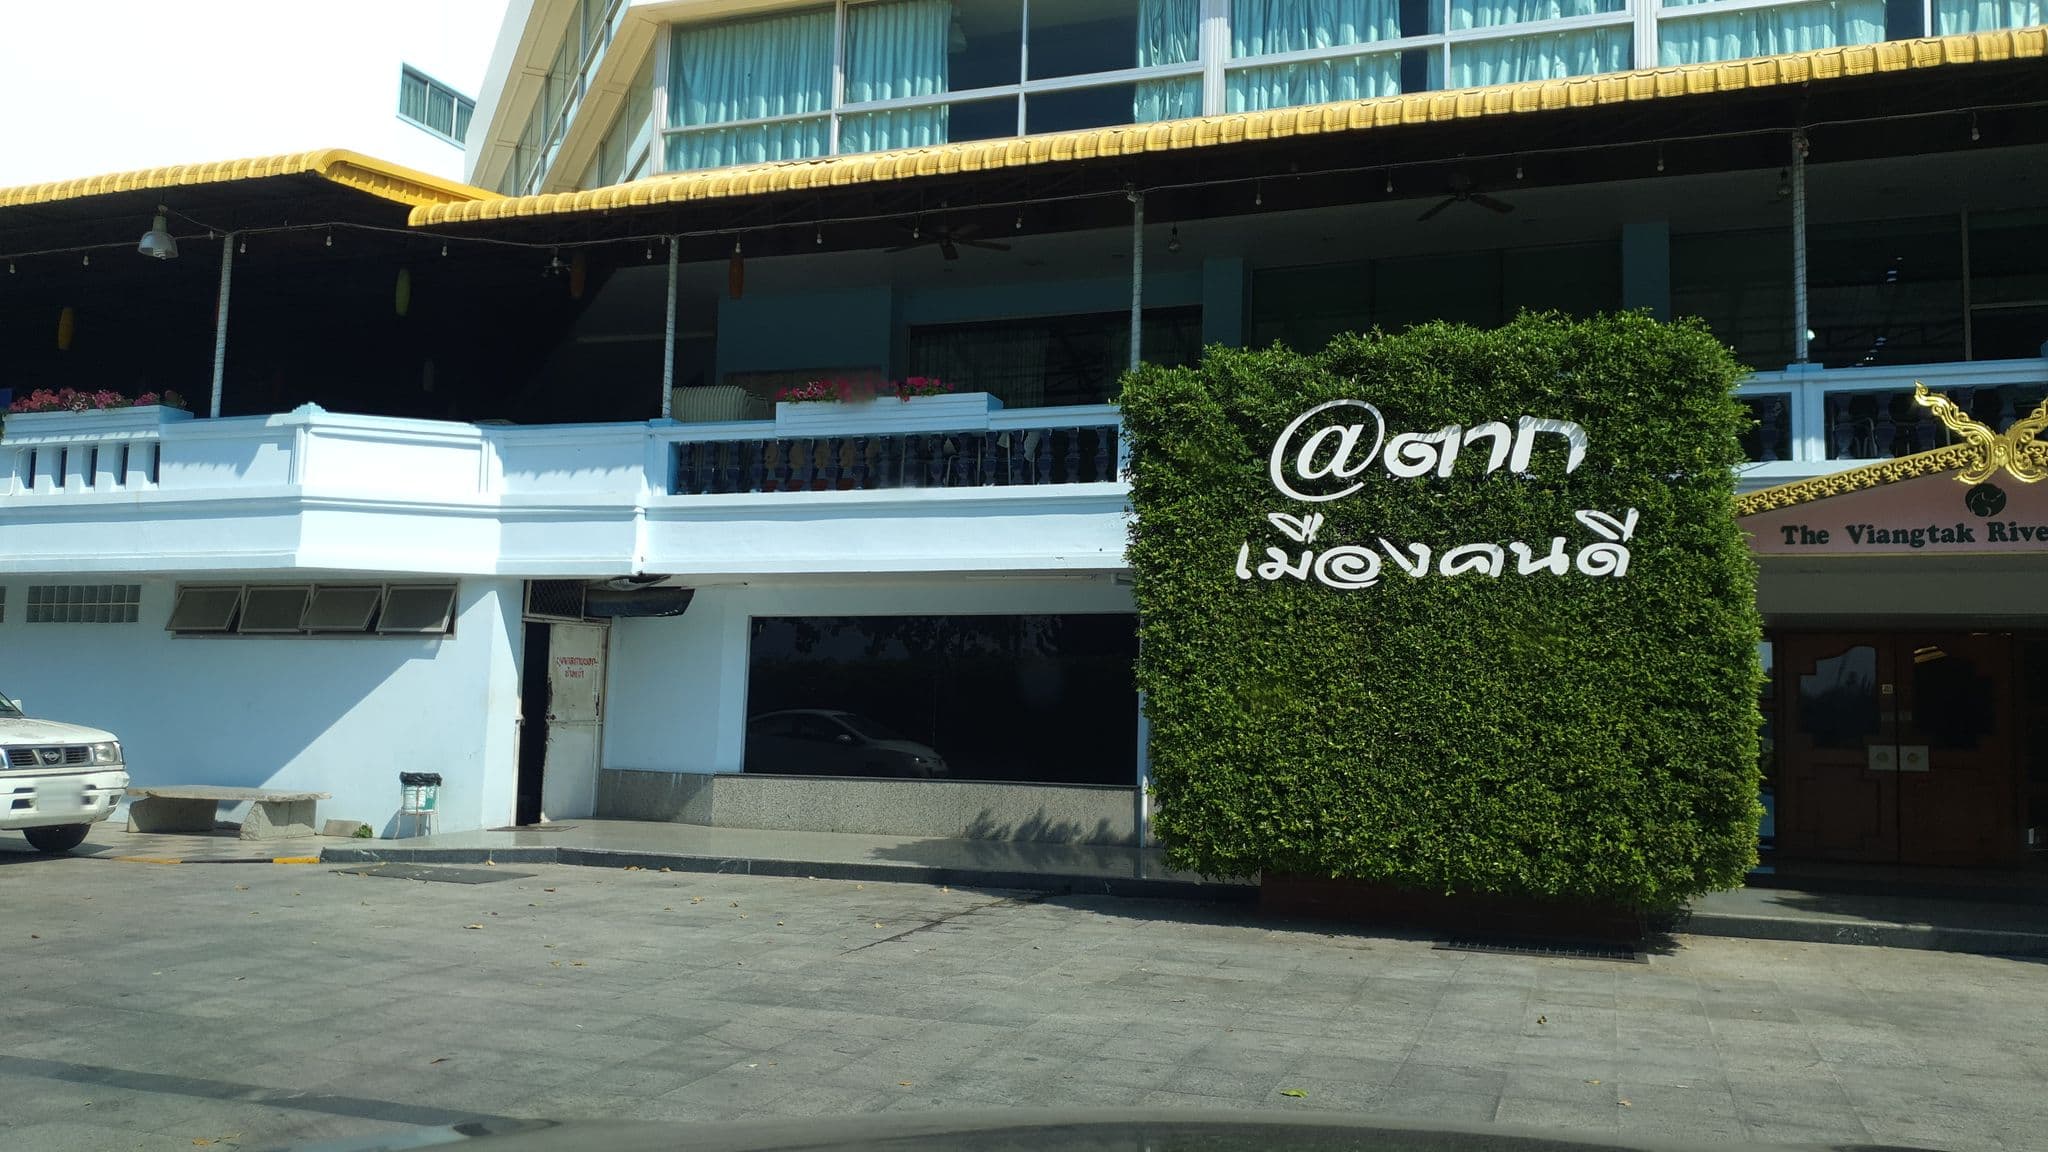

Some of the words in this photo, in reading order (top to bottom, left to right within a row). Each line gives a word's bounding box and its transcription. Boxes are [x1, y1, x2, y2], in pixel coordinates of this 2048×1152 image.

[1271, 399, 1589, 502] @ตาก
[1236, 507, 1639, 590] เมืองคนดี
[1780, 524, 1829, 545] The
[1845, 522, 1976, 548] Viangtak
